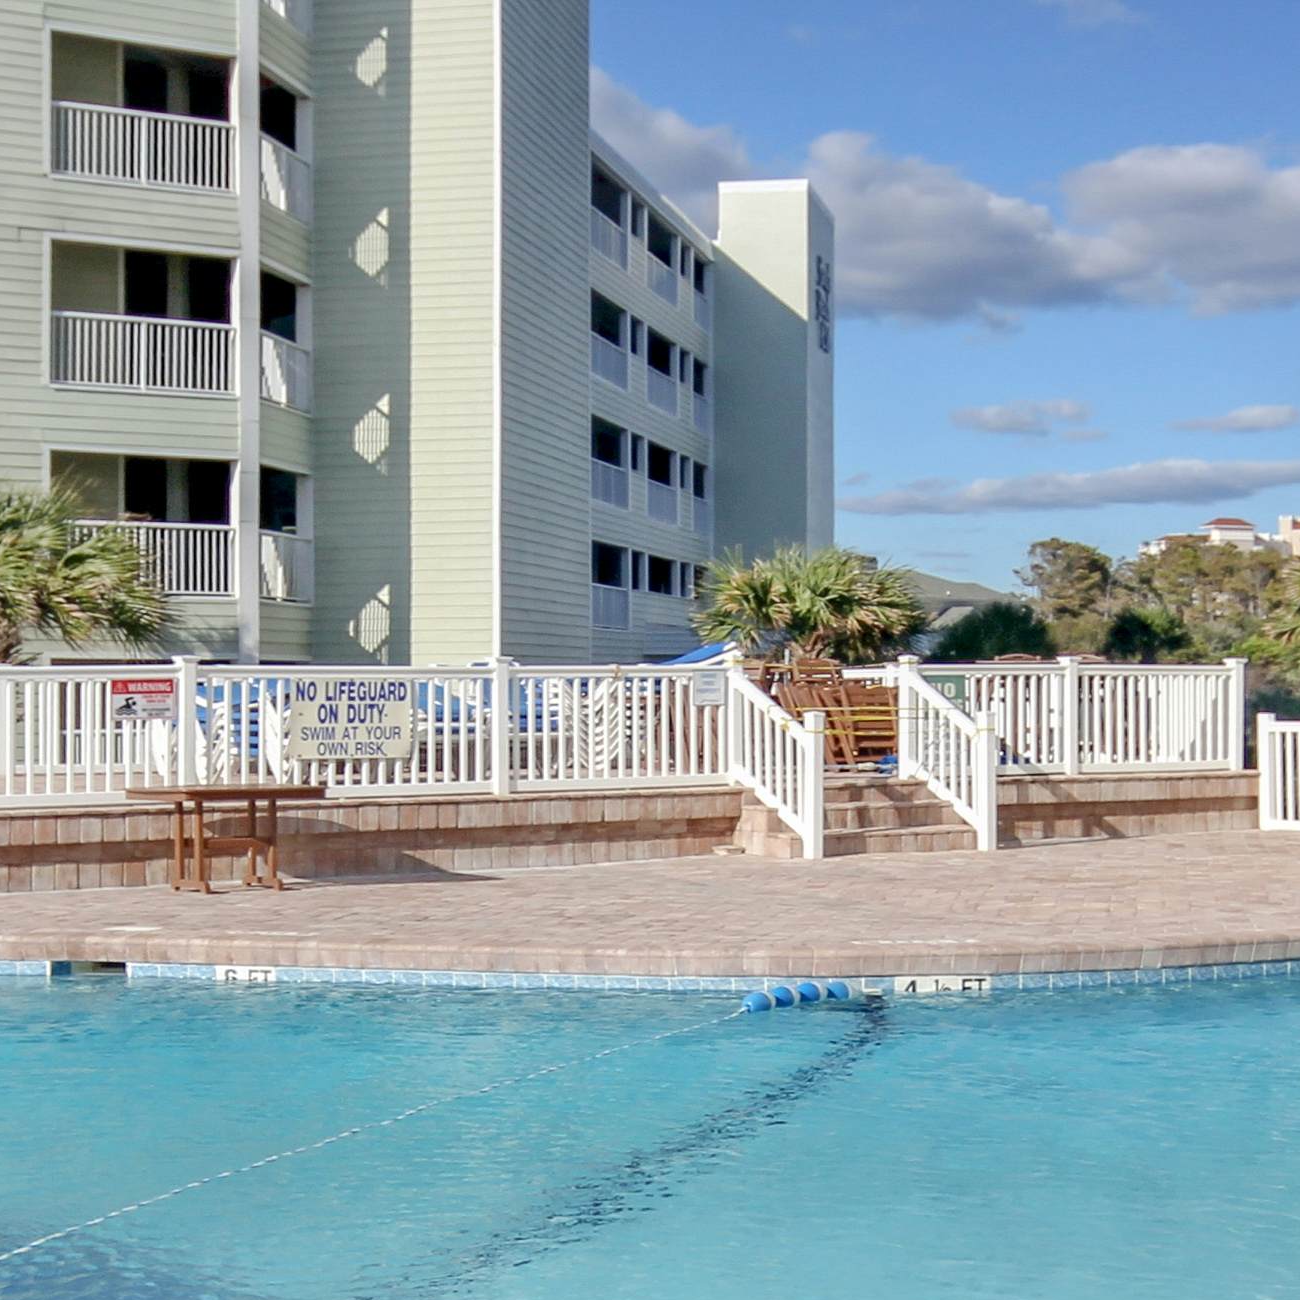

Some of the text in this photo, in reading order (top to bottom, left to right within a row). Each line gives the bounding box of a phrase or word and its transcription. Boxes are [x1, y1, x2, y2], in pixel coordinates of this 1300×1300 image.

[296, 681, 407, 702] NO LIFEGUARD
[317, 703, 385, 724] ON DUTY
[301, 726, 401, 741] SWIM AT YOUR
[317, 741, 387, 756] OWN RISK
